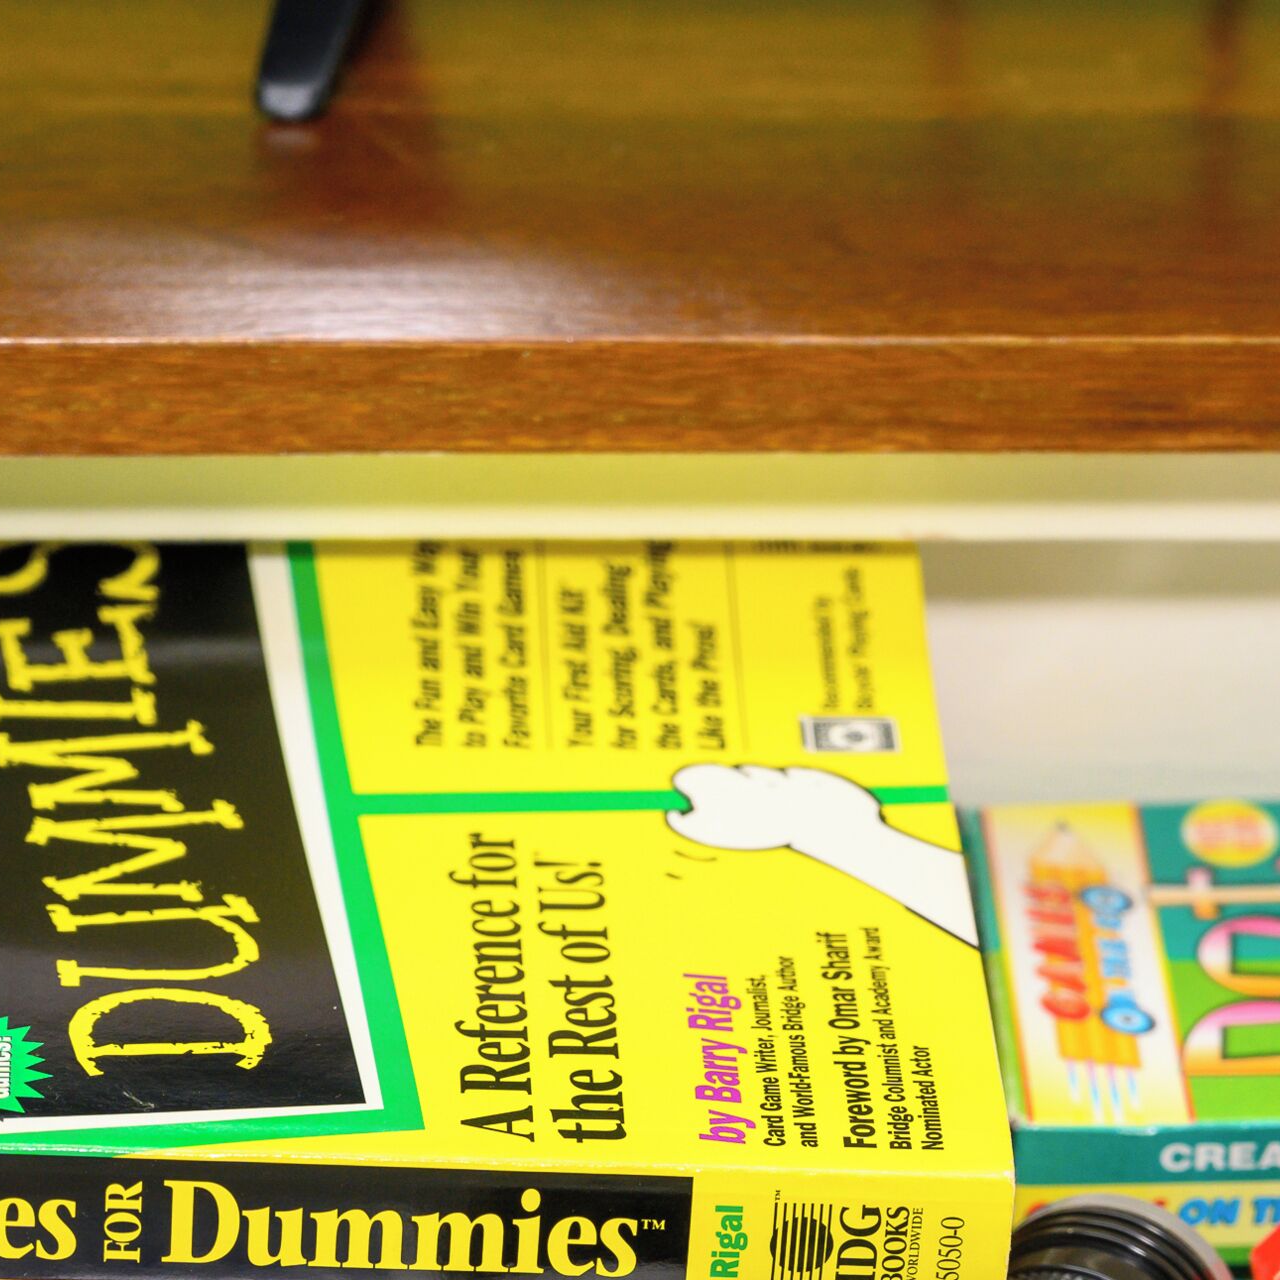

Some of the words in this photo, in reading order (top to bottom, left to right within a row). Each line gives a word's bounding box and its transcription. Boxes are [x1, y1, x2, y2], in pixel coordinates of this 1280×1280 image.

[415, 636, 441, 672] and
[458, 642, 484, 679] and
[498, 623, 527, 668] Card
[414, 679, 442, 711] Fun
[502, 675, 531, 748] Favorite
[415, 717, 443, 746] The
[448, 831, 518, 889] for
[532, 857, 607, 914] Us!
[537, 921, 612, 964] of
[815, 931, 855, 981] Sharif
[860, 926, 883, 962] Award
[776, 955, 801, 993] Author
[867, 964, 892, 1017] Academy
[453, 899, 534, 1096] Reference
[547, 974, 621, 1060] Rest
[682, 972, 743, 1033] Rigal
[780, 995, 807, 1032] Bridge
[827, 985, 862, 1030] Omar
[831, 1034, 872, 1056] by
[872, 1017, 897, 1041] and
[694, 1037, 748, 1104] Barry
[787, 1034, 816, 1120] World-Famous
[876, 1043, 907, 1104] Columnist
[910, 1045, 932, 1078] Actor
[549, 1069, 628, 1144] the
[759, 1076, 783, 1112] Game
[832, 1060, 878, 1150] Foreword
[914, 1080, 945, 1151] Nominated
[459, 1105, 536, 1143] A
[698, 1109, 757, 1145] by
[762, 1114, 787, 1148] Card
[793, 1121, 819, 1149] and
[886, 1105, 916, 1150] Bridge
[102, 1180, 144, 1264] FOR
[1178, 1198, 1241, 1226] ON
[709, 1204, 748, 1279] Rigal
